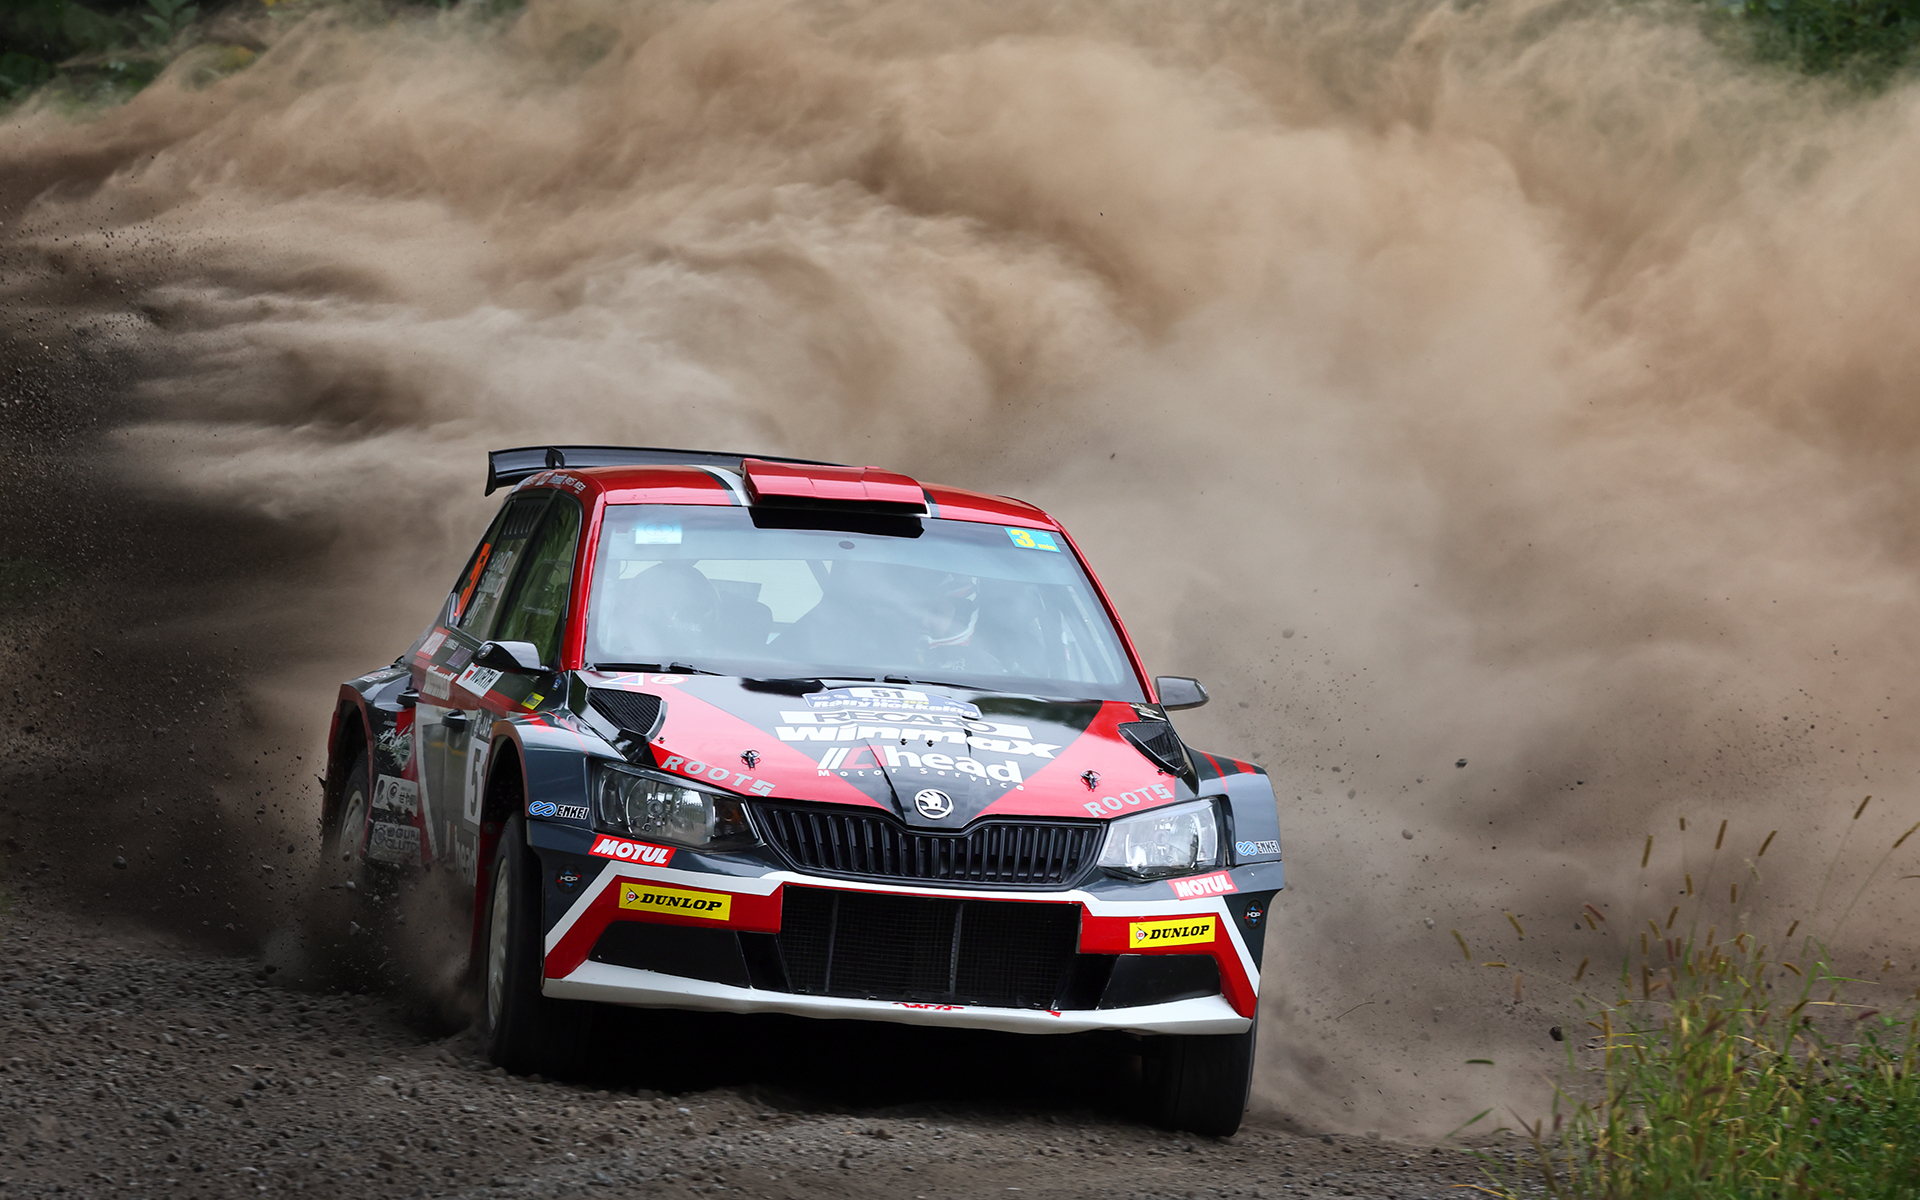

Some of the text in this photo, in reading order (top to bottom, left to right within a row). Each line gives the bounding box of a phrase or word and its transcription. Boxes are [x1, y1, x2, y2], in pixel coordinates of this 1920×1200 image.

[1011, 530, 1035, 547] 3
[871, 690, 904, 698] 51
[813, 700, 871, 708] Rally
[872, 702, 978, 717] Hokkaido
[811, 711, 997, 732] RECARO
[775, 724, 1062, 759] winmax
[817, 745, 1023, 784] Ahead
[661, 755, 776, 797] ROOTS
[818, 768, 1025, 791] Motor Service
[1083, 784, 1173, 817] ROOTS
[557, 805, 588, 819] ENKEI
[594, 838, 669, 864] MOTUL
[1255, 841, 1281, 854] ENKEI
[1176, 875, 1233, 897] MOTUL
[640, 893, 722, 911] DUNLOP
[1149, 925, 1210, 939] DUNLOP
